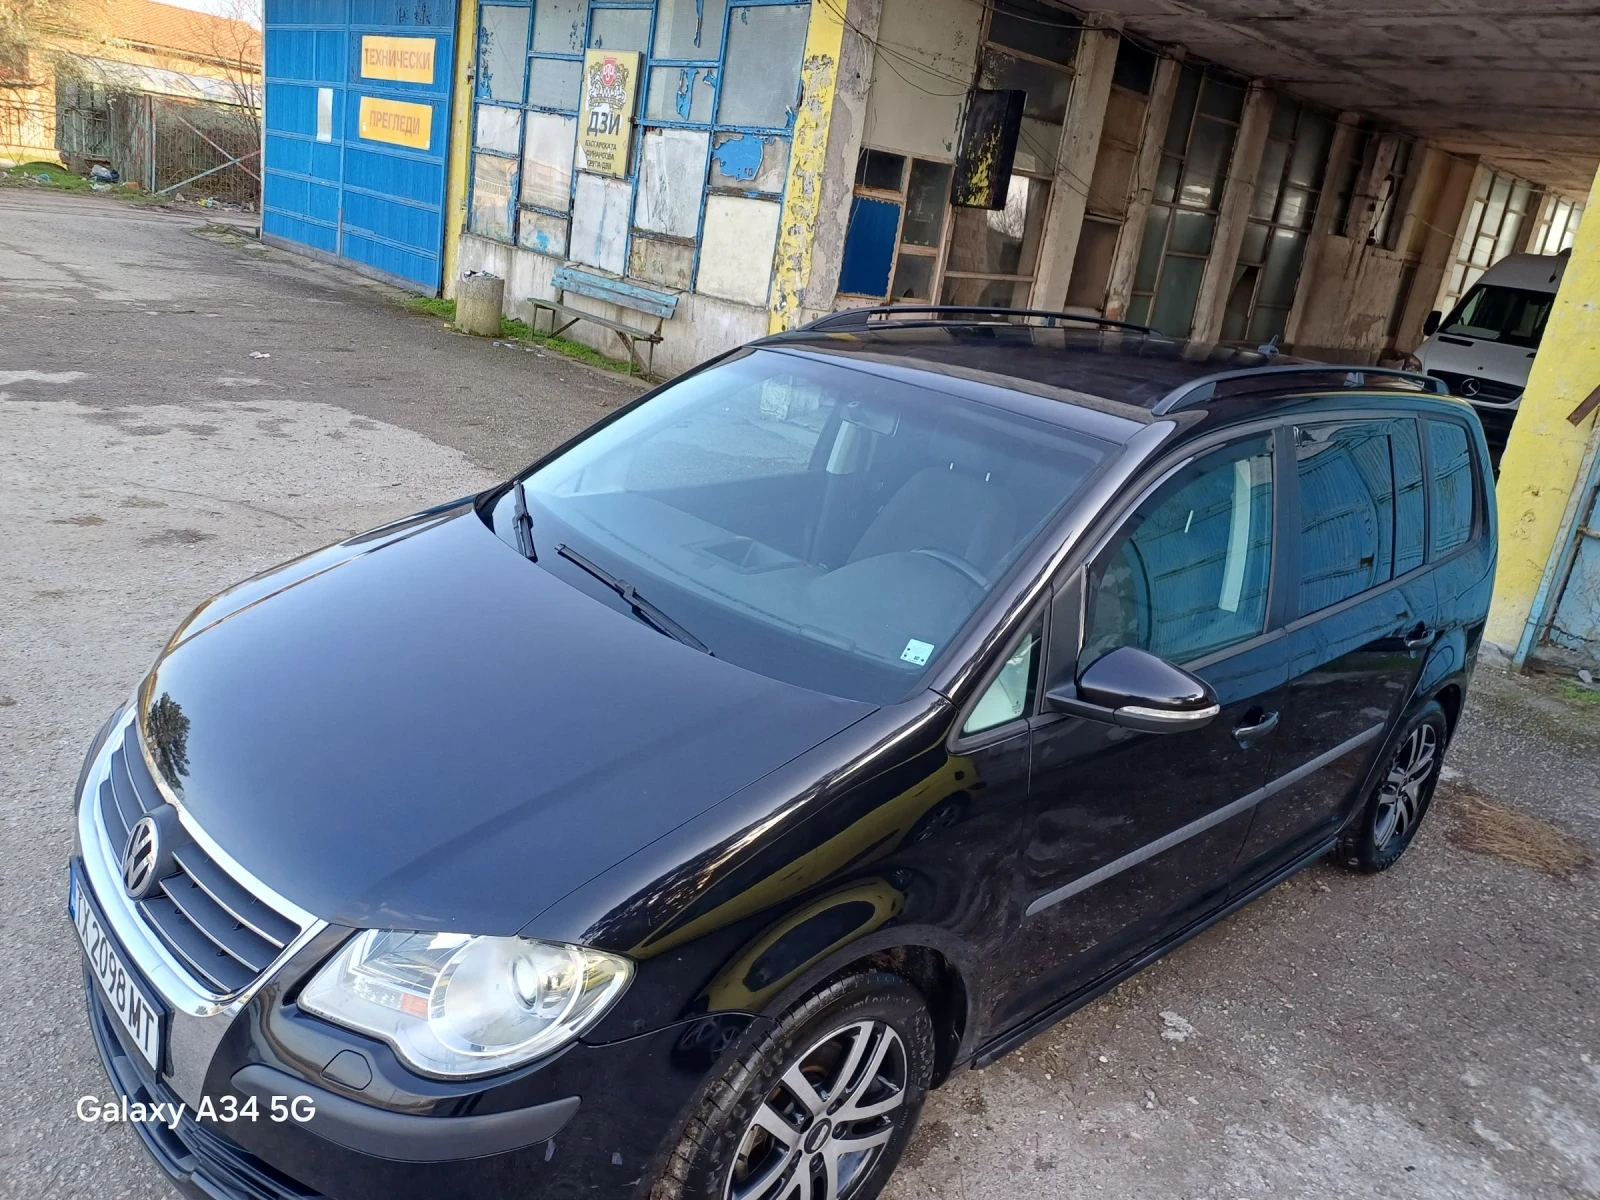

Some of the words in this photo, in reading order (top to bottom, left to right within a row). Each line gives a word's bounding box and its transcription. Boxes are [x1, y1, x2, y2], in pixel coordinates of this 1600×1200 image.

[365, 48, 431, 71] ТЕХНИЧЕСКИ
[369, 110, 421, 136] ПРЕГЛЕДИ
[586, 111, 621, 136] ДЗИ
